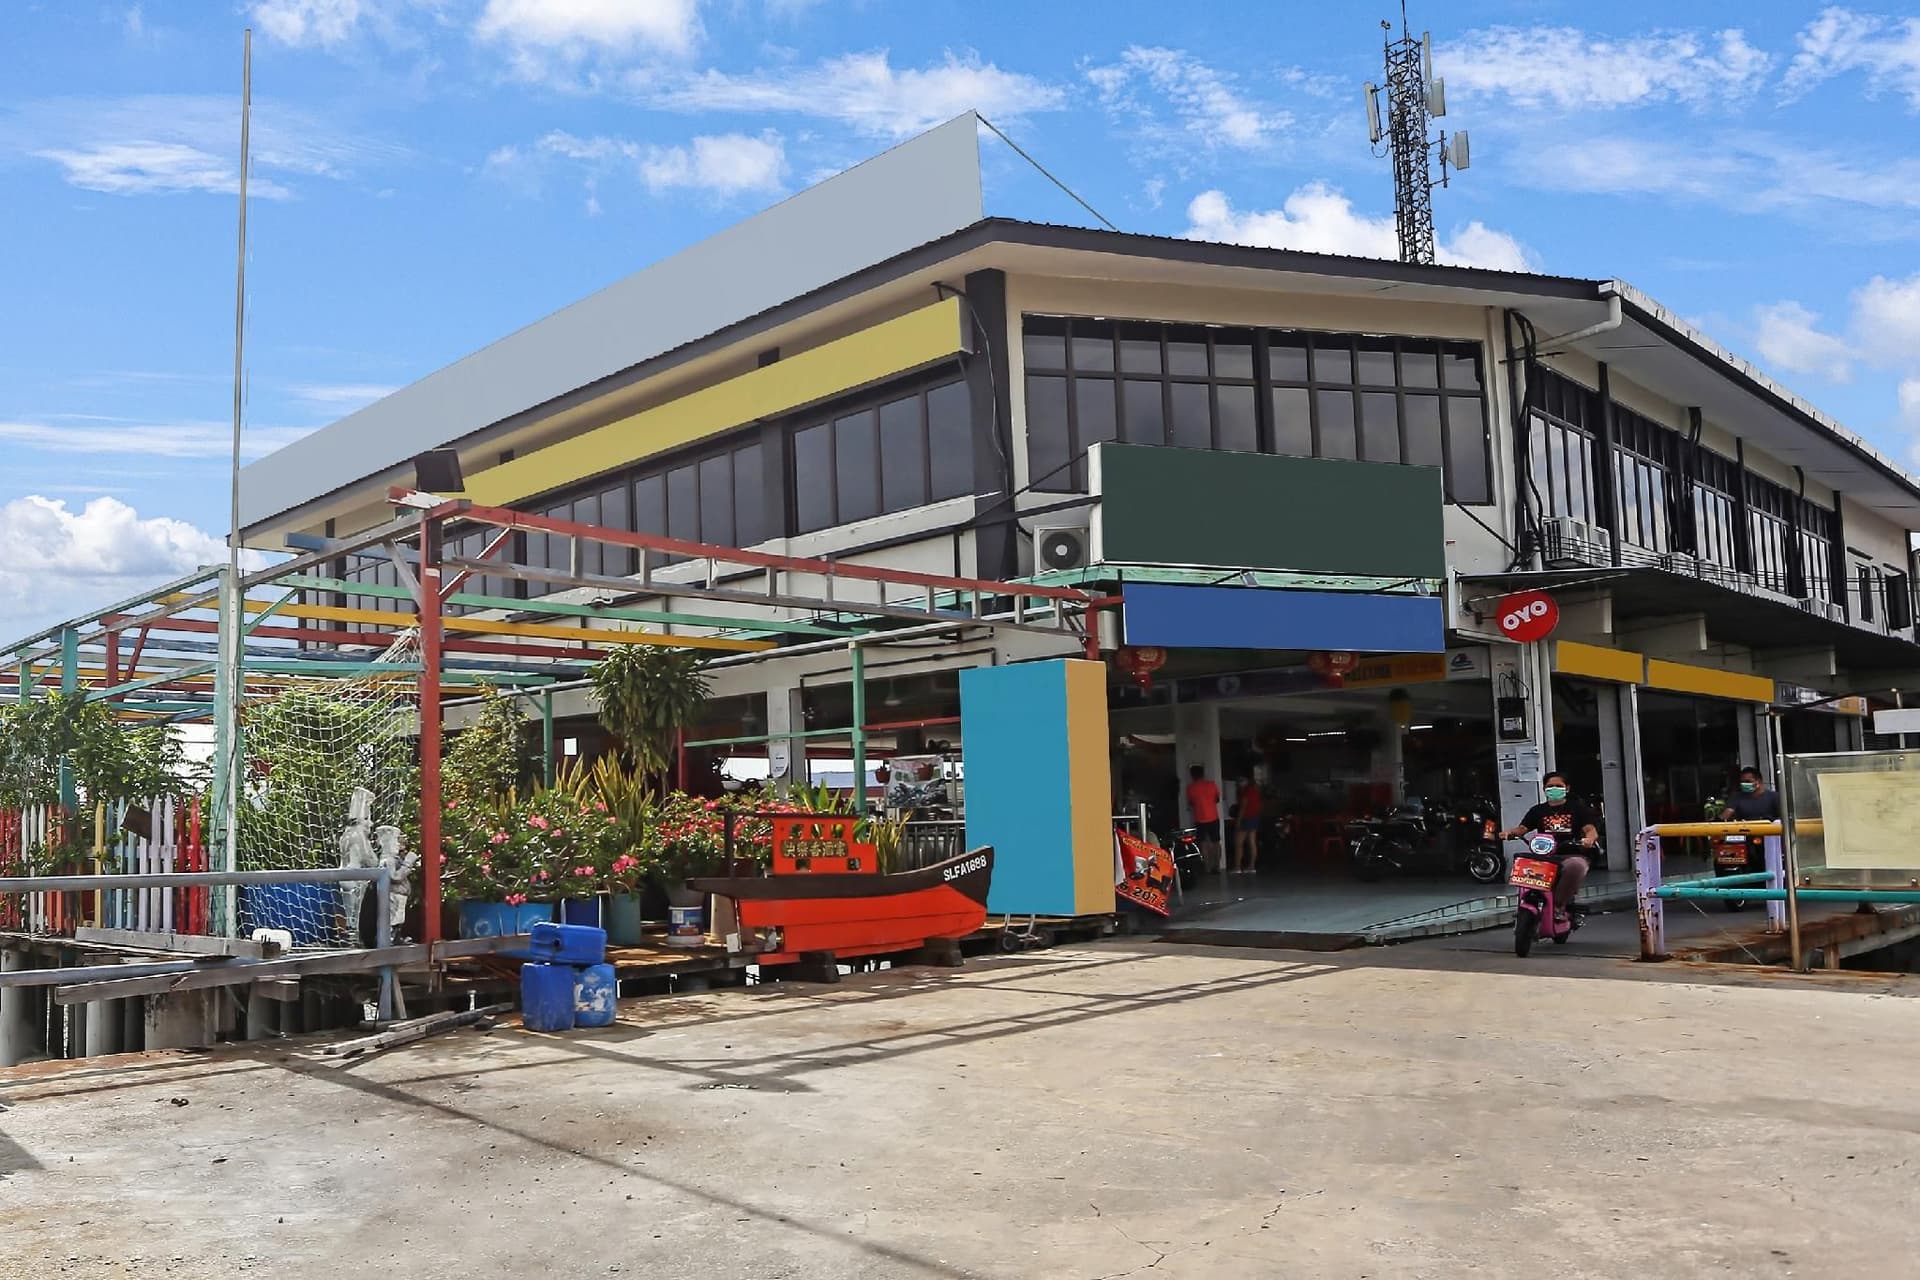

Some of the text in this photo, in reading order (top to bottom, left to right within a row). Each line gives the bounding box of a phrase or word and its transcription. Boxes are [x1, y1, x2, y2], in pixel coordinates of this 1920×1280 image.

[1503, 600, 1547, 630] OYO
[943, 855, 987, 881] SLFA1688
[1132, 887, 1158, 904] 207
